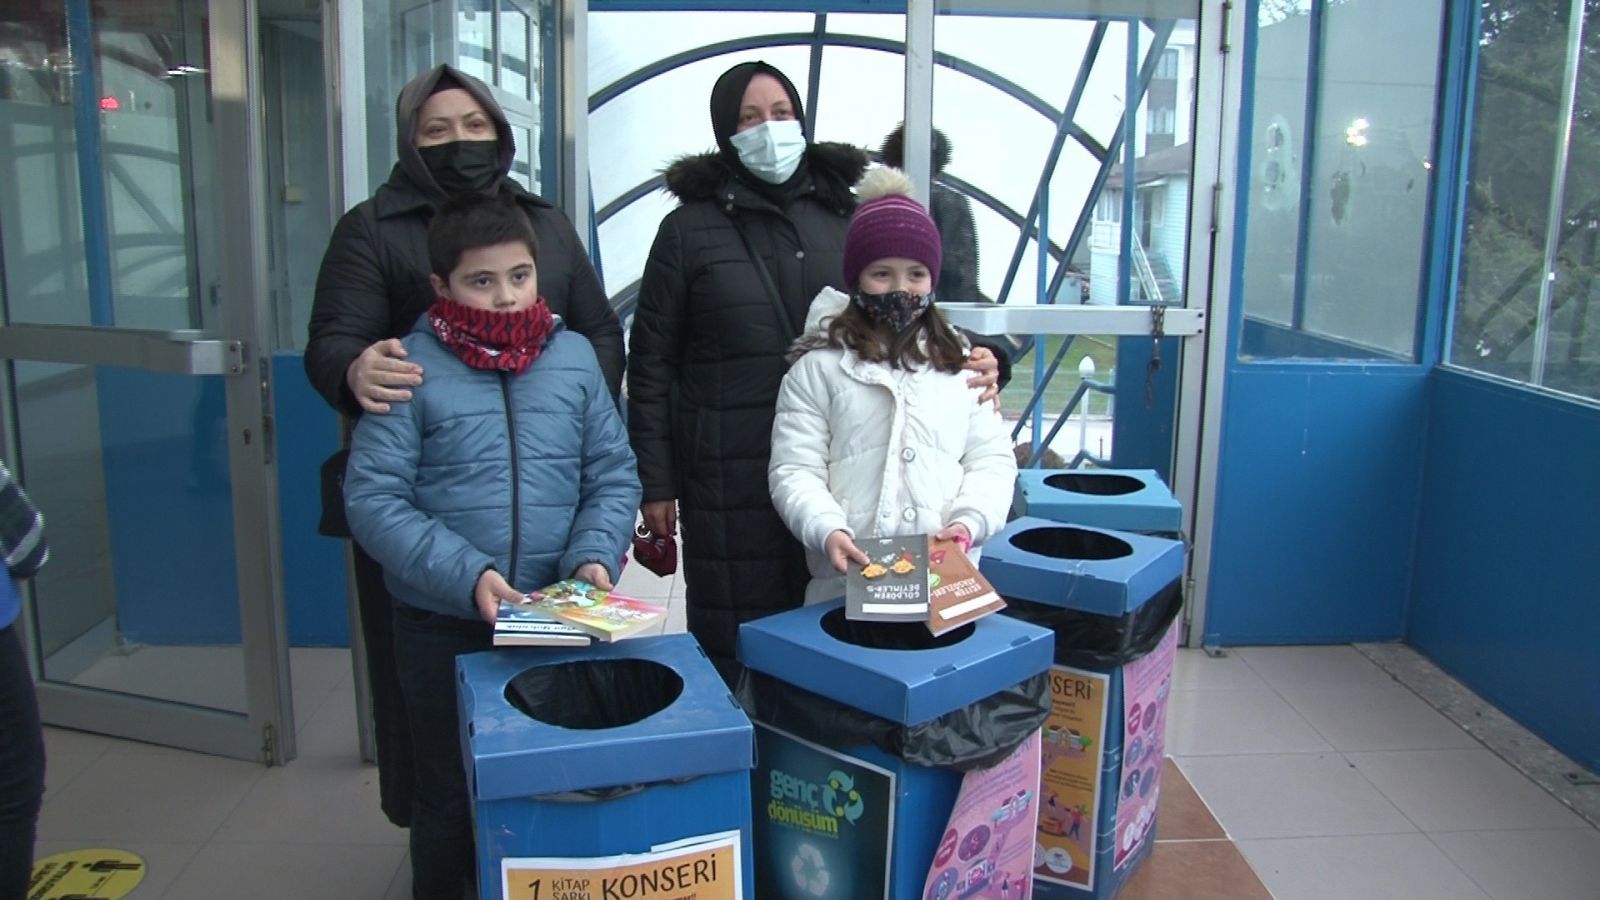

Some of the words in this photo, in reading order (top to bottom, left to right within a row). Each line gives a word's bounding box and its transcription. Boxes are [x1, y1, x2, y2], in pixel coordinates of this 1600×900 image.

[1048, 674, 1091, 700] SERİ
[770, 769, 818, 813] genç
[528, 879, 541, 900] 1
[552, 877, 590, 891] KİTAP
[602, 853, 716, 900] KONSERİ
